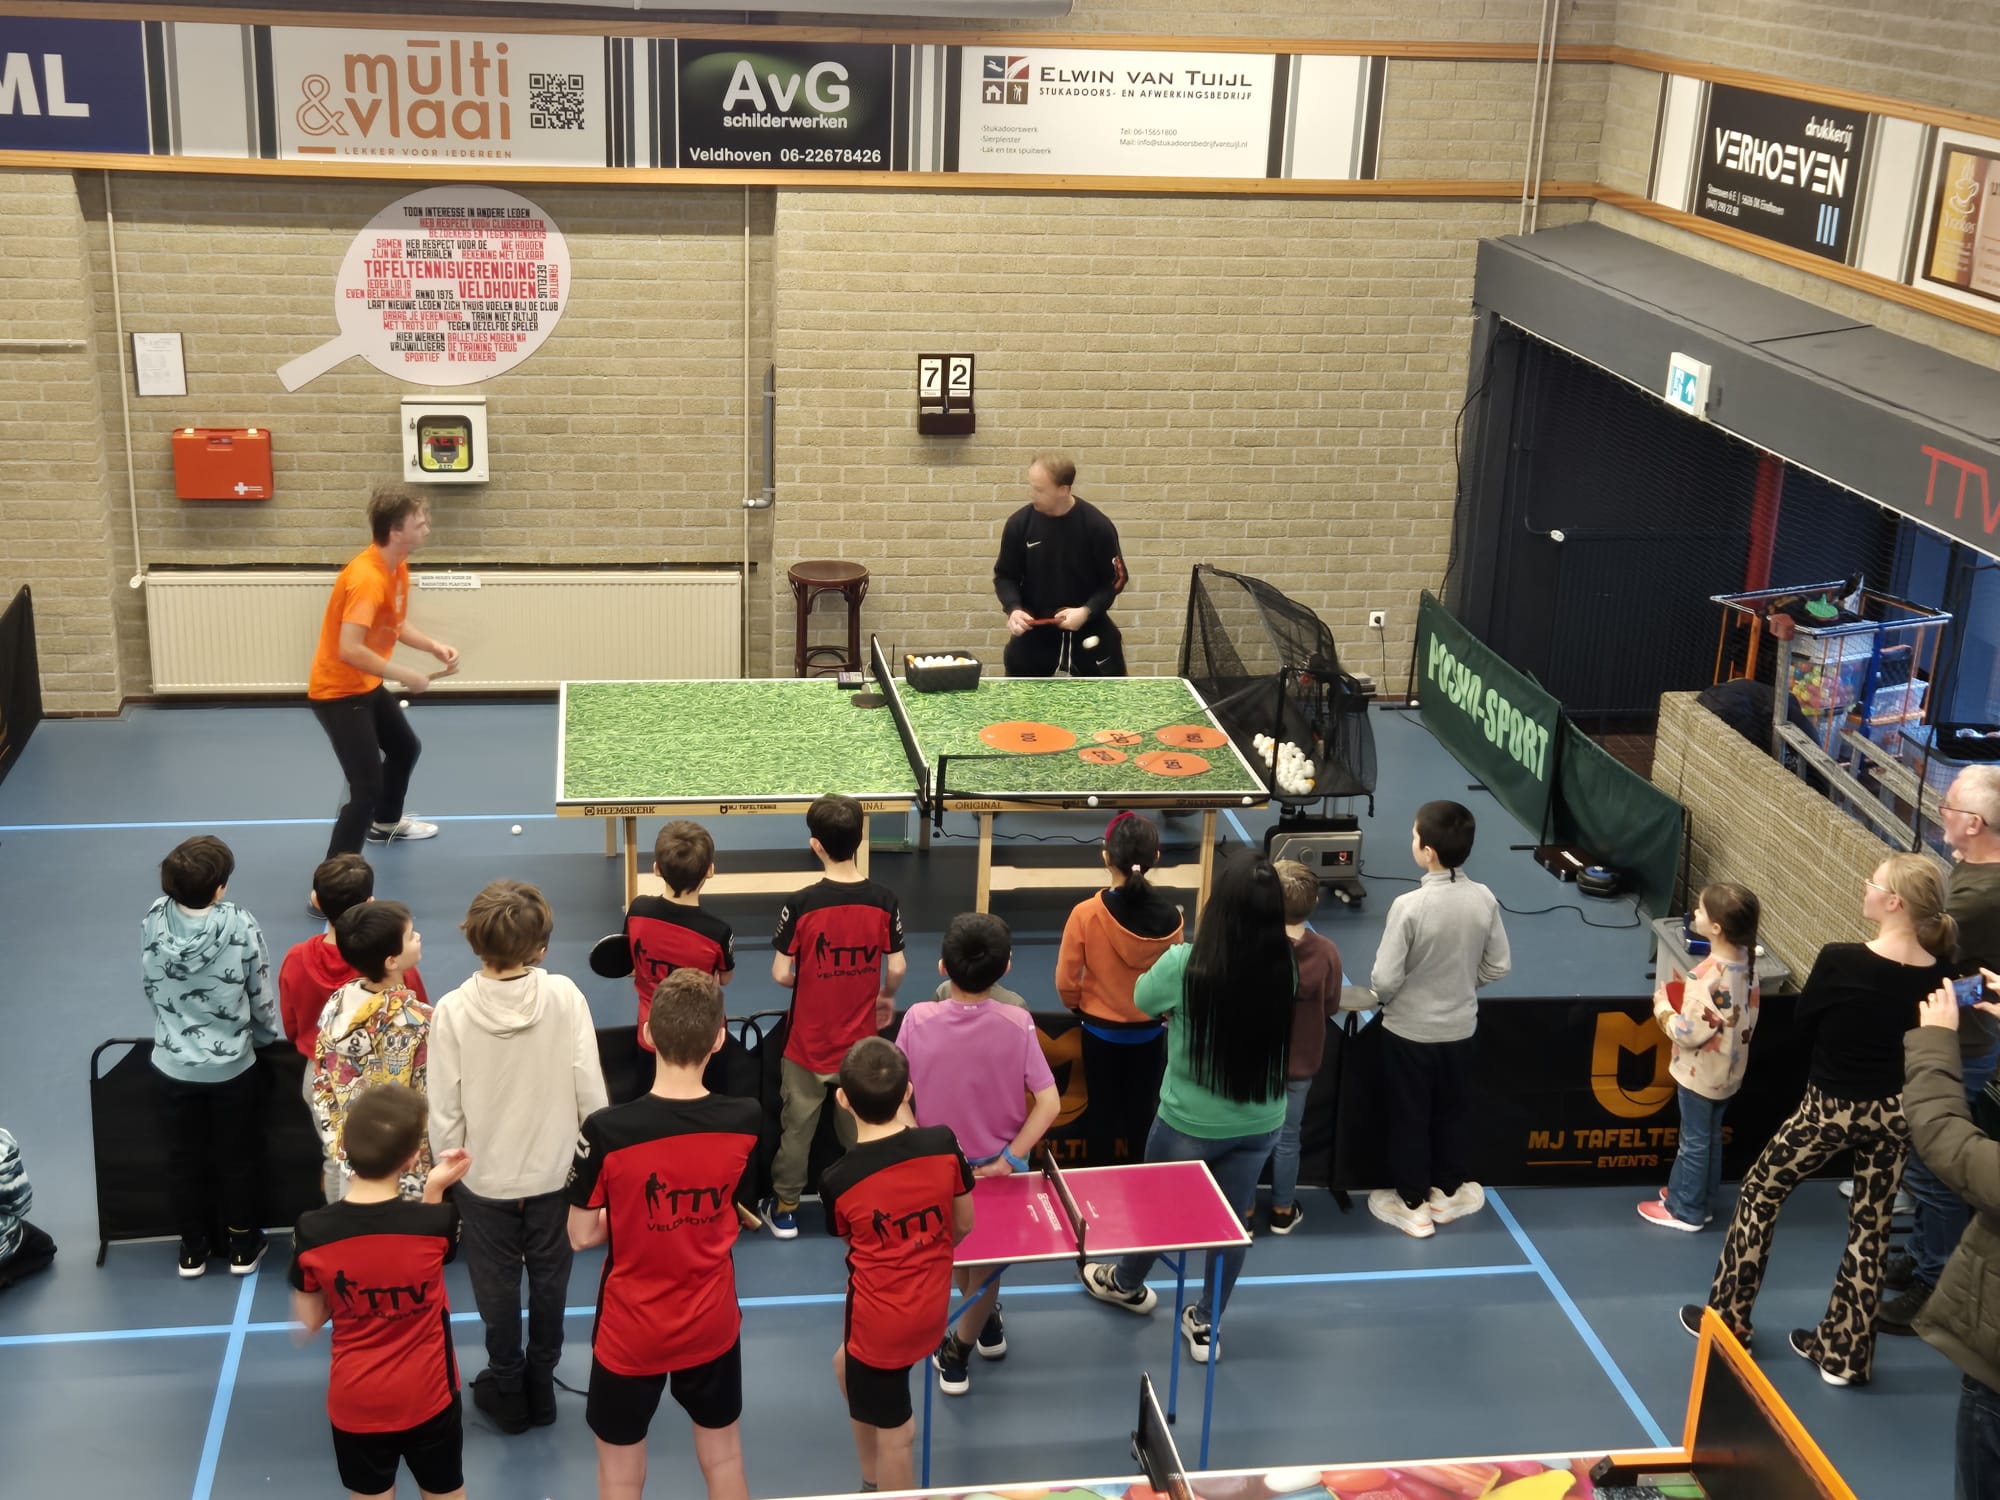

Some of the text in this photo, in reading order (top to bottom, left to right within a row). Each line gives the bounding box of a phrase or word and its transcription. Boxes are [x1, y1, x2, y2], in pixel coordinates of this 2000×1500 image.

[1040, 67, 1114, 84] ELWIN
[1185, 70, 1252, 87] TUIJL
[723, 59, 850, 113] AvG
[1039, 87, 1252, 100] STUKADOORS- EN AFWERKINGSBEDRIJF
[723, 113, 848, 129] schilderwerken
[1805, 115, 1854, 152] drukkerij
[345, 147, 512, 159] LEKKER VOOR IEDEREEN
[689, 147, 881, 163] Veldhoven 06-22678426
[1716, 127, 1848, 198] VERHOEVEN
[403, 207, 423, 217] TOON
[425, 207, 465, 217] INTERESSE
[467, 208, 475, 217] IN
[508, 208, 530, 218] LEDEN
[376, 239, 402, 248] SAMEN
[406, 239, 487, 249] HEB RESPECT VOOR DE
[501, 240, 513, 250] WE
[371, 249, 402, 258] ZIJN WE
[406, 250, 453, 259] MATERIALEN
[462, 250, 497, 259] REKENING
[499, 250, 514, 260] MET
[364, 260, 536, 279] TAFELTENNISVERENIGING
[368, 279, 388, 289] IEDER
[537, 264, 547, 299] GEZELLIG
[346, 288, 365, 298] EVEN
[437, 290, 454, 300] 1975
[459, 281, 536, 299] VELDHOVEN
[368, 300, 559, 311] LAAT NIEUWE LEDEN ZICH THUIS VOELEN BIJ DE CLUB
[409, 311, 418, 320] JE
[420, 311, 462, 321] VERENIGING
[471, 312, 538, 321] TRAIN NIET ALTIJD
[384, 321, 438, 330] MET TROTS UIT
[448, 321, 539, 331] TEGEN DEZELFDE SPELER
[396, 332, 445, 341] HIER WERKEN
[448, 333, 488, 342] BALLETJES
[490, 333, 515, 342] MOGEN
[390, 342, 446, 352] VRIJWILLIGERS
[448, 343, 457, 352] DE
[459, 343, 492, 352] TRAINING
[405, 352, 440, 362] SPORTIEF
[448, 352, 455, 361] IN
[457, 352, 466, 361] DE
[924, 367, 939, 388] 7
[951, 364, 967, 385] 2
[955, 801, 1003, 810] ORIGINAL
[596, 806, 656, 816] HEEMSKERK
[830, 945, 878, 967] TTV
[646, 957, 681, 977] TT
[1528, 1126, 1734, 1149] MJ TAFELTES
[1597, 1154, 1659, 1168] EVENTS
[665, 1183, 730, 1216] TTV
[358, 1280, 430, 1310] TTV
